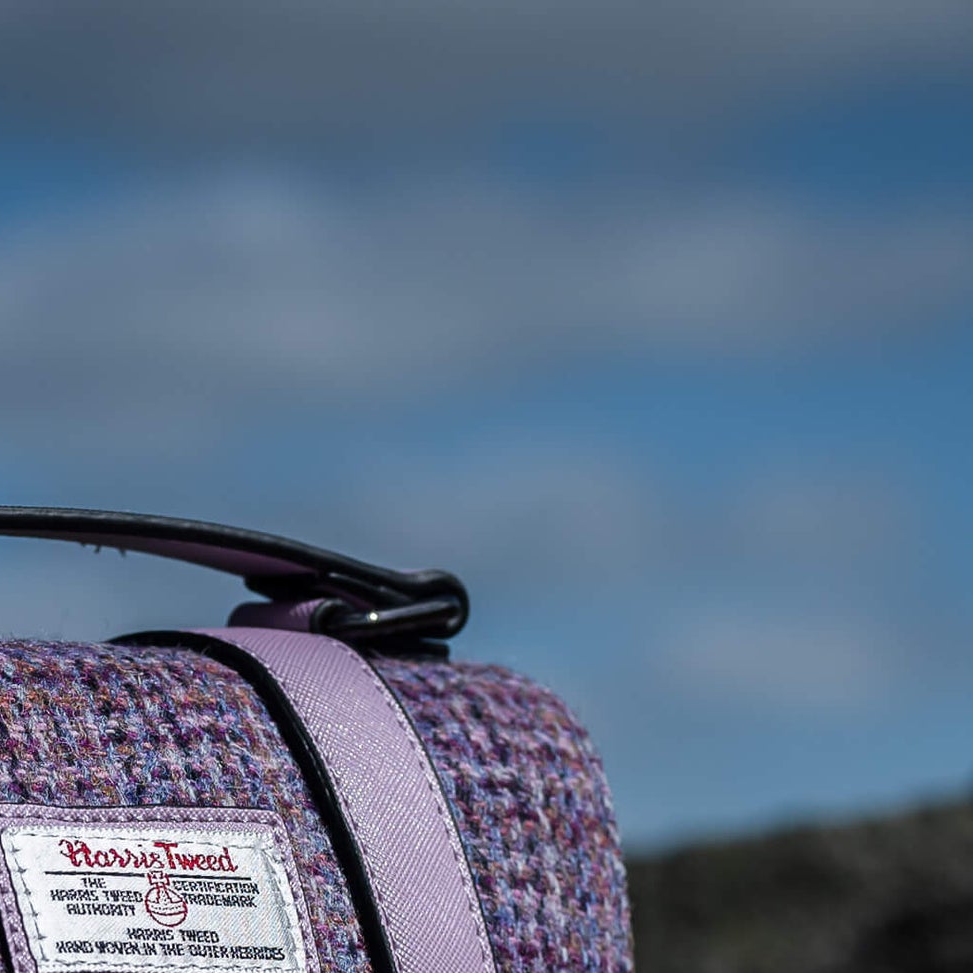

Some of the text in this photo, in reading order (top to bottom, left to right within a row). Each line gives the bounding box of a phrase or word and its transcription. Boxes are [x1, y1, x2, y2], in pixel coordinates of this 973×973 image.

[58, 839, 238, 872] Harris Tweed
[80, 877, 107, 889] THE
[172, 880, 260, 895] CERTIFICATION
[50, 889, 144, 903] HARRIS TWEED
[182, 892, 257, 908] TRADEMARK
[67, 903, 136, 916] AUTHORITY
[126, 928, 219, 943] HARRIS TWEED
[55, 941, 286, 961] HAND WOVEN IN THE OUTER HEBRIDES
